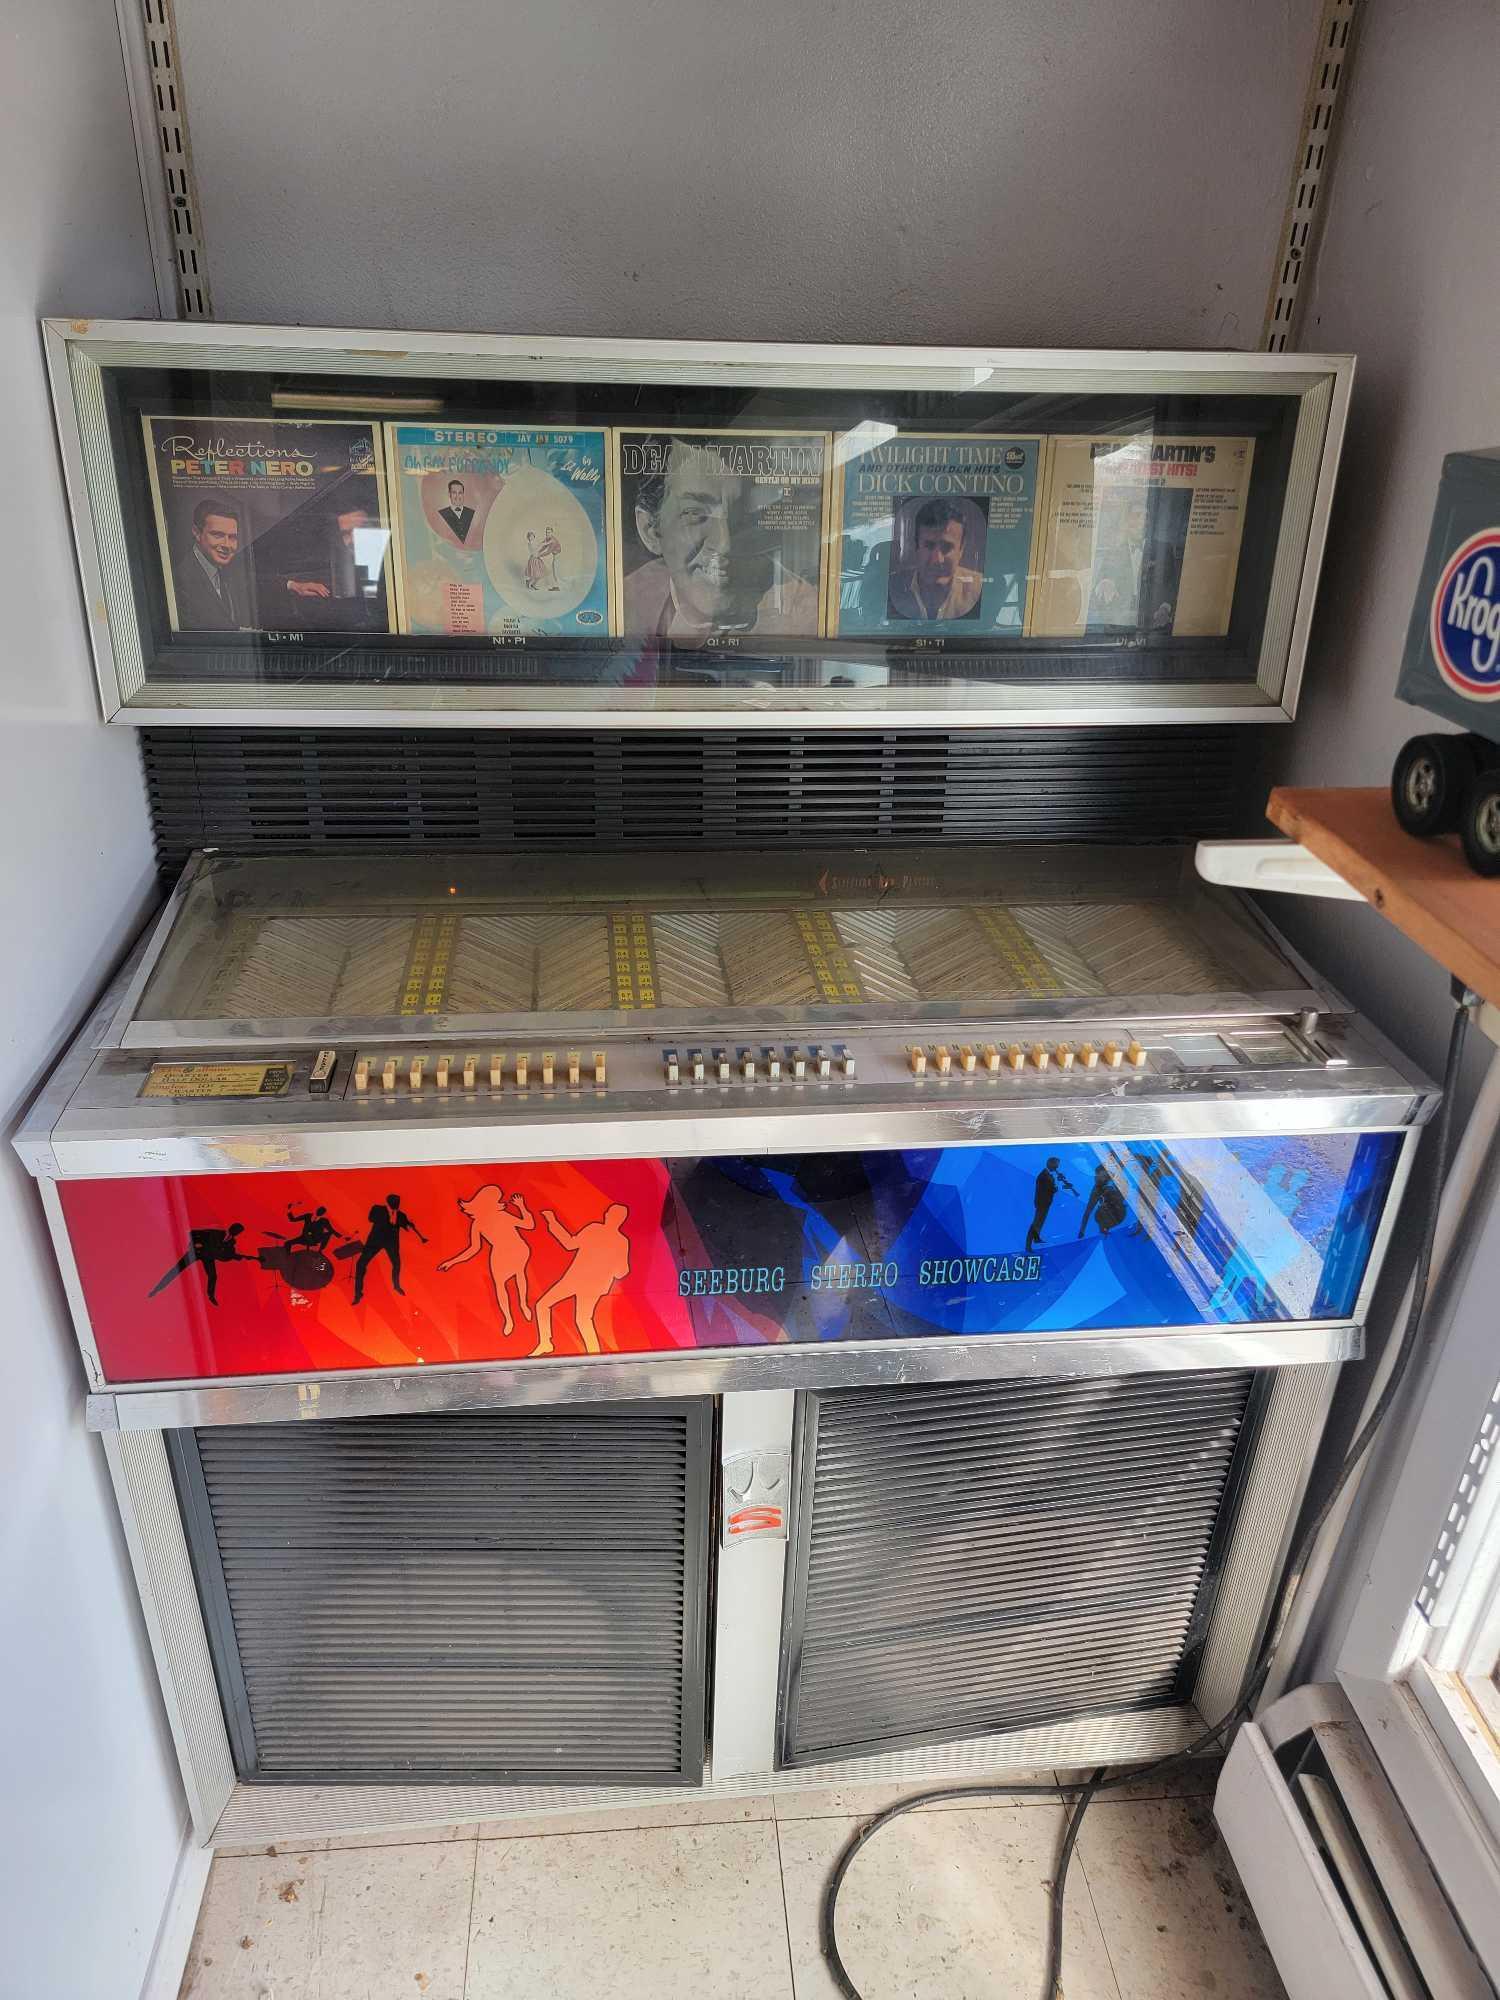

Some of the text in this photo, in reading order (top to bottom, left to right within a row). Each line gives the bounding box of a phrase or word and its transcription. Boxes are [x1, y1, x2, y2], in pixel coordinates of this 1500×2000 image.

[434, 430, 498, 443] STEREO
[517, 433, 532, 444] JAY
[553, 434, 573, 444] 5079
[162, 435, 317, 461] Reflections
[858, 446, 1003, 465] TWILIGHT TIME
[171, 459, 314, 477] PETER NERO
[705, 445, 823, 477] MARTIN
[858, 464, 1001, 474] AND OTHER GOLDEN HITS
[1167, 463, 1198, 477] HITS!
[571, 466, 601, 486] Wally
[858, 474, 1024, 495] DICK CONTINO
[679, 1256, 1041, 1297] SEEBURG STEREO SHOWCASE
